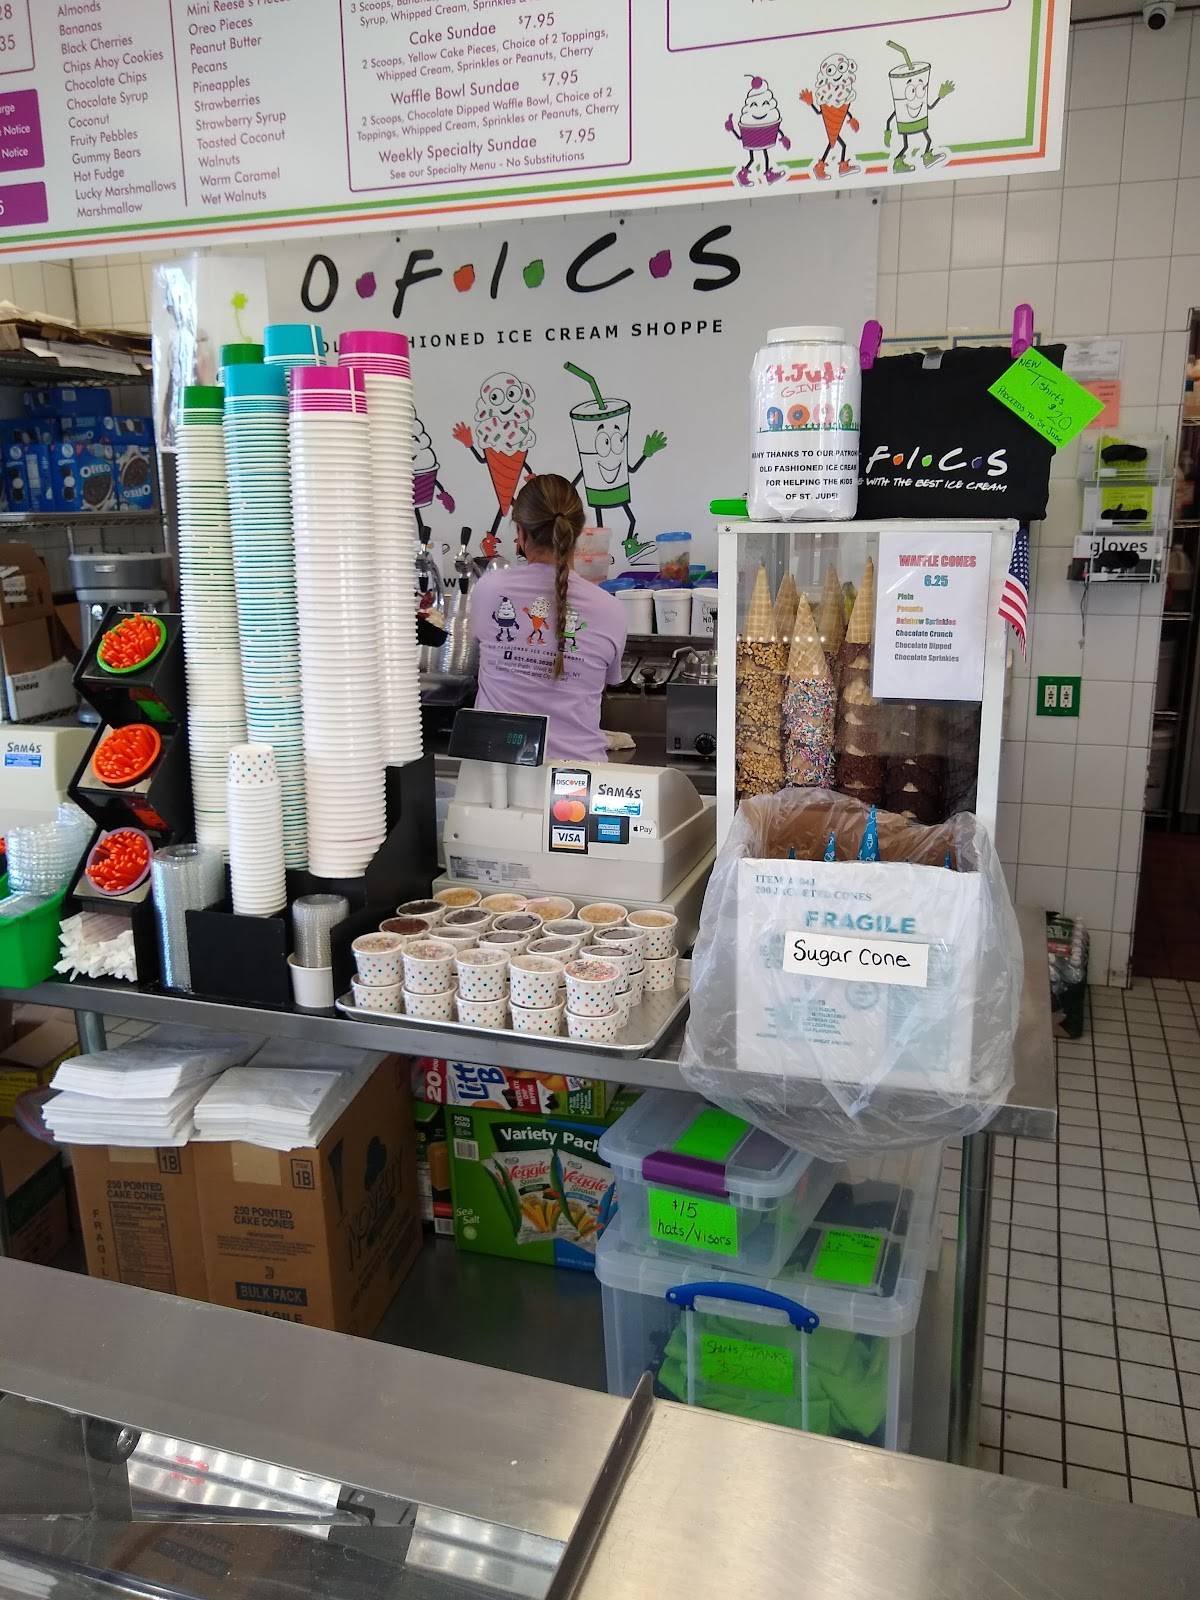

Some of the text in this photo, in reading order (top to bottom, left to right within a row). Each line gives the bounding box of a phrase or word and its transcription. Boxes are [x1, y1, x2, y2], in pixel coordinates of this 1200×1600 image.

[57, 1, 102, 18] Almonds
[186, 2, 211, 16] Mini
[360, 4, 470, 29] Syrup, Whipped Cream,
[59, 21, 103, 37] Bananas
[188, 17, 254, 36] Oreo Pieces
[409, 12, 555, 46] Cake Sundae $7.95
[61, 33, 134, 55] Black Cherries
[190, 35, 263, 55] Peanut Butter
[370, 28, 609, 69] Scoops, Yellow Cake Pieces, Choice Toppings,
[63, 49, 165, 75] Chips Ahoy Cookies
[191, 60, 228, 74] Pecans
[376, 46, 594, 82] Whipped Cream, Sprinkles Peanuts, Cherry
[64, 71, 148, 93] Chocolate Chips
[193, 75, 251, 93] Pineapples
[390, 69, 578, 105] Waffle Bowl Sundae $7.95
[66, 90, 149, 111] Chocolate Syrup
[194, 94, 261, 112] Strawberries
[370, 90, 590, 126] Scoops, Chocolate Dipped Waffle Bowl, Choice
[68, 114, 110, 129] Coconut
[195, 110, 287, 131] Strawberry Syrup
[357, 102, 620, 143] Toppings, Whipped Cream, Sprinkles Peanuts, Cherry
[70, 128, 139, 147] Fruity Pebbles
[196, 129, 286, 150] Toasted Coconut
[378, 127, 596, 164] Weekly Specialty Sundae $7.95
[72, 147, 142, 165] Gummy Bears
[197, 154, 240, 168] Walnuts
[389, 151, 585, 180] See Specialty Menu No Substitutions
[73, 167, 125, 183] Hot Fudge
[199, 167, 281, 187] Warm Caramel
[75, 180, 177, 200] Lucky Marshmallows
[201, 189, 267, 205] Wet Walnuts
[76, 202, 143, 218] Marshmallow
[497, 318, 724, 344] ICE CREAM SHOPPE
[1018, 358, 1042, 369] NEW
[766, 450, 800, 459] THANKS
[801, 450, 814, 458] TO
[816, 450, 834, 458] OUR
[80, 463, 111, 478] OREO
[759, 464, 838, 473] OLD FASHIONED ICE
[765, 479, 781, 487] FOR
[782, 478, 821, 487] HELPING
[823, 478, 838, 486] THE
[866, 477, 891, 487] WITH
[893, 477, 913, 487] THE
[914, 478, 944, 489] BEST
[944, 480, 964, 490] ICE
[965, 481, 1008, 494] CREAM
[785, 493, 797, 501] OF
[1090, 537, 1148, 559] gloves
[898, 554, 977, 568] WAFFLE CONES
[924, 574, 949, 587] 6.25
[897, 593, 914, 601] Plain
[925, 617, 957, 626] Sprinkles
[895, 629, 953, 639] Chocolate Crunch
[894, 641, 952, 651] Chocolate Dipped
[894, 653, 960, 663] Chocolate Sprinkles
[7, 742, 42, 754] SAM4S
[597, 783, 642, 799] SAM4S
[557, 831, 581, 843] VISA
[639, 824, 654, 835] Pay
[804, 910, 917, 935] FRAGILE
[793, 938, 853, 967] Sugar
[858, 948, 912, 973] Cone
[500, 1127, 559, 1146] Variety
[161, 1155, 178, 1171] 1B
[295, 1170, 312, 1186] 1B
[508, 1163, 551, 1182] Veggie
[563, 1167, 609, 1192] Veggie
[122, 1180, 163, 1192] POINTED
[106, 1189, 165, 1202] CAKE CONES
[252, 1207, 292, 1220] POINTED
[456, 1207, 474, 1217] Sea
[672, 1199, 699, 1219] $15
[233, 1215, 295, 1231] CAKE CONES
[462, 1214, 481, 1225] Salt
[240, 1284, 304, 1303] BULK PACK
